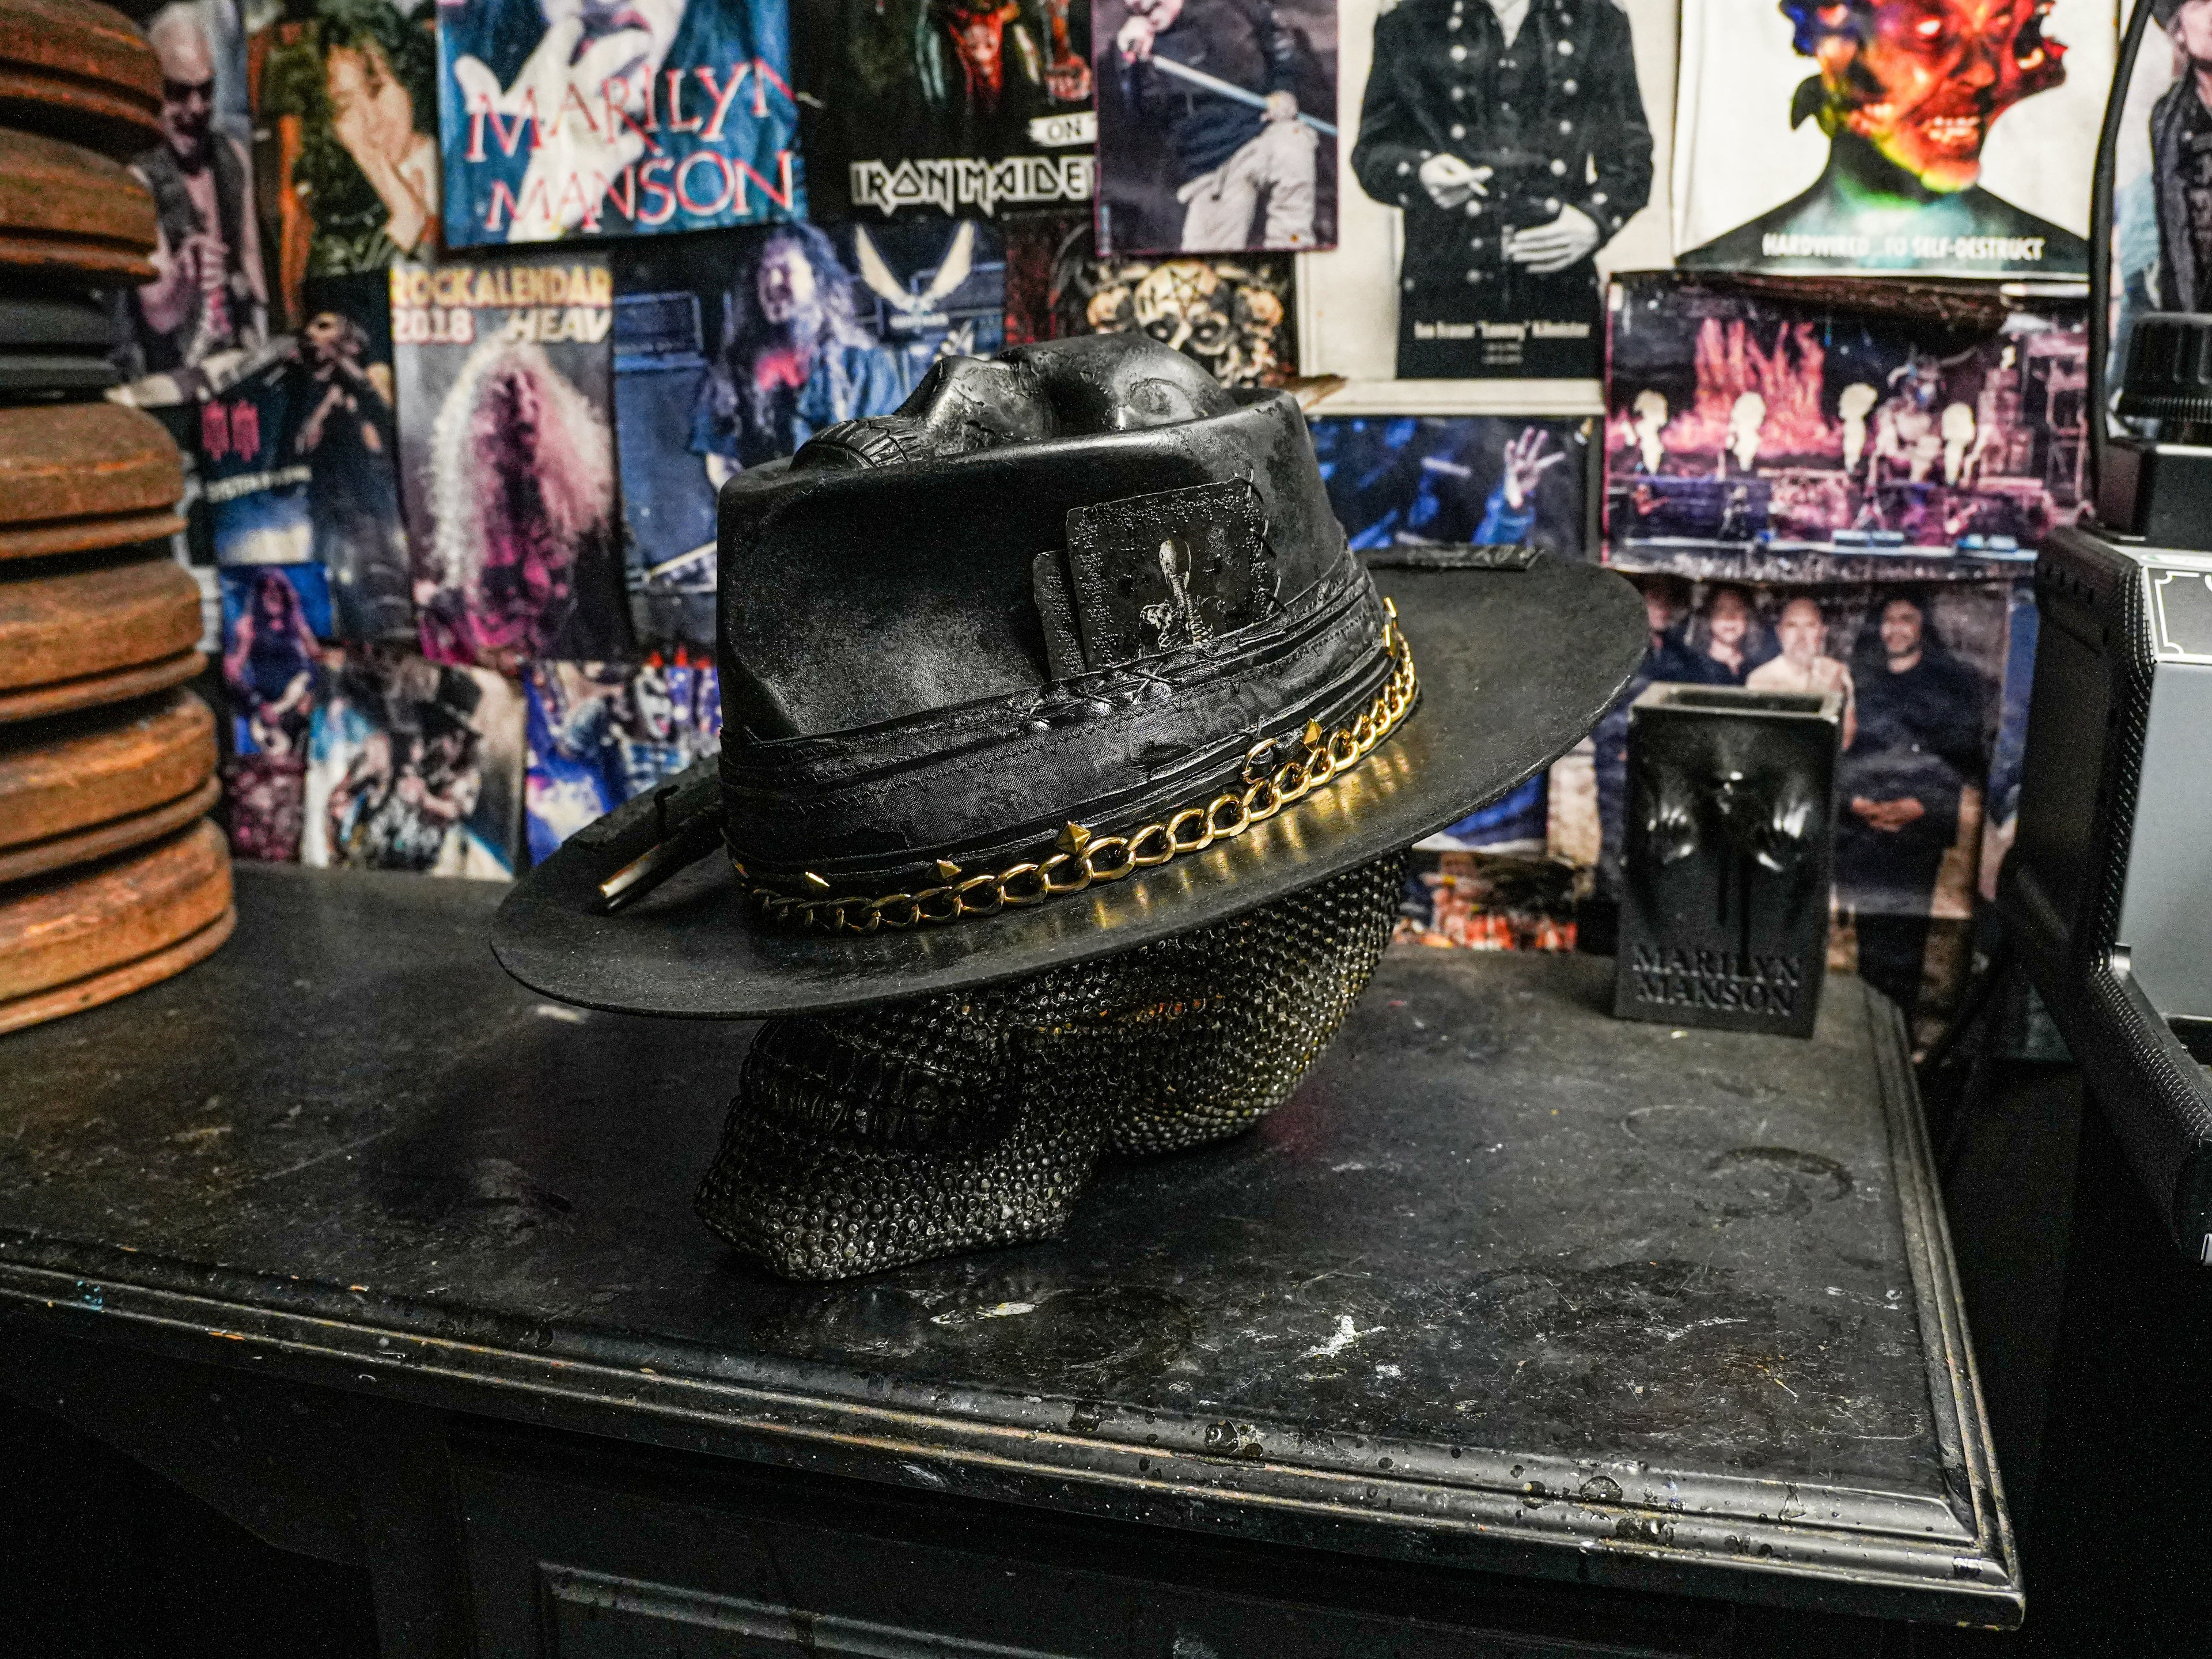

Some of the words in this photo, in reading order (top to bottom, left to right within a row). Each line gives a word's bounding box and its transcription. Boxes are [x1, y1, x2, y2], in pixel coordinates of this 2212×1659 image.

[466, 58, 798, 162] MARILYN
[485, 151, 796, 233] MANSON
[850, 158, 956, 217] IRON
[1911, 235, 2046, 261] SELF-DESTRUCT
[391, 307, 475, 345] 2018
[1632, 942, 1800, 987] MARILYN
[1634, 974, 1793, 1017] MANSON
